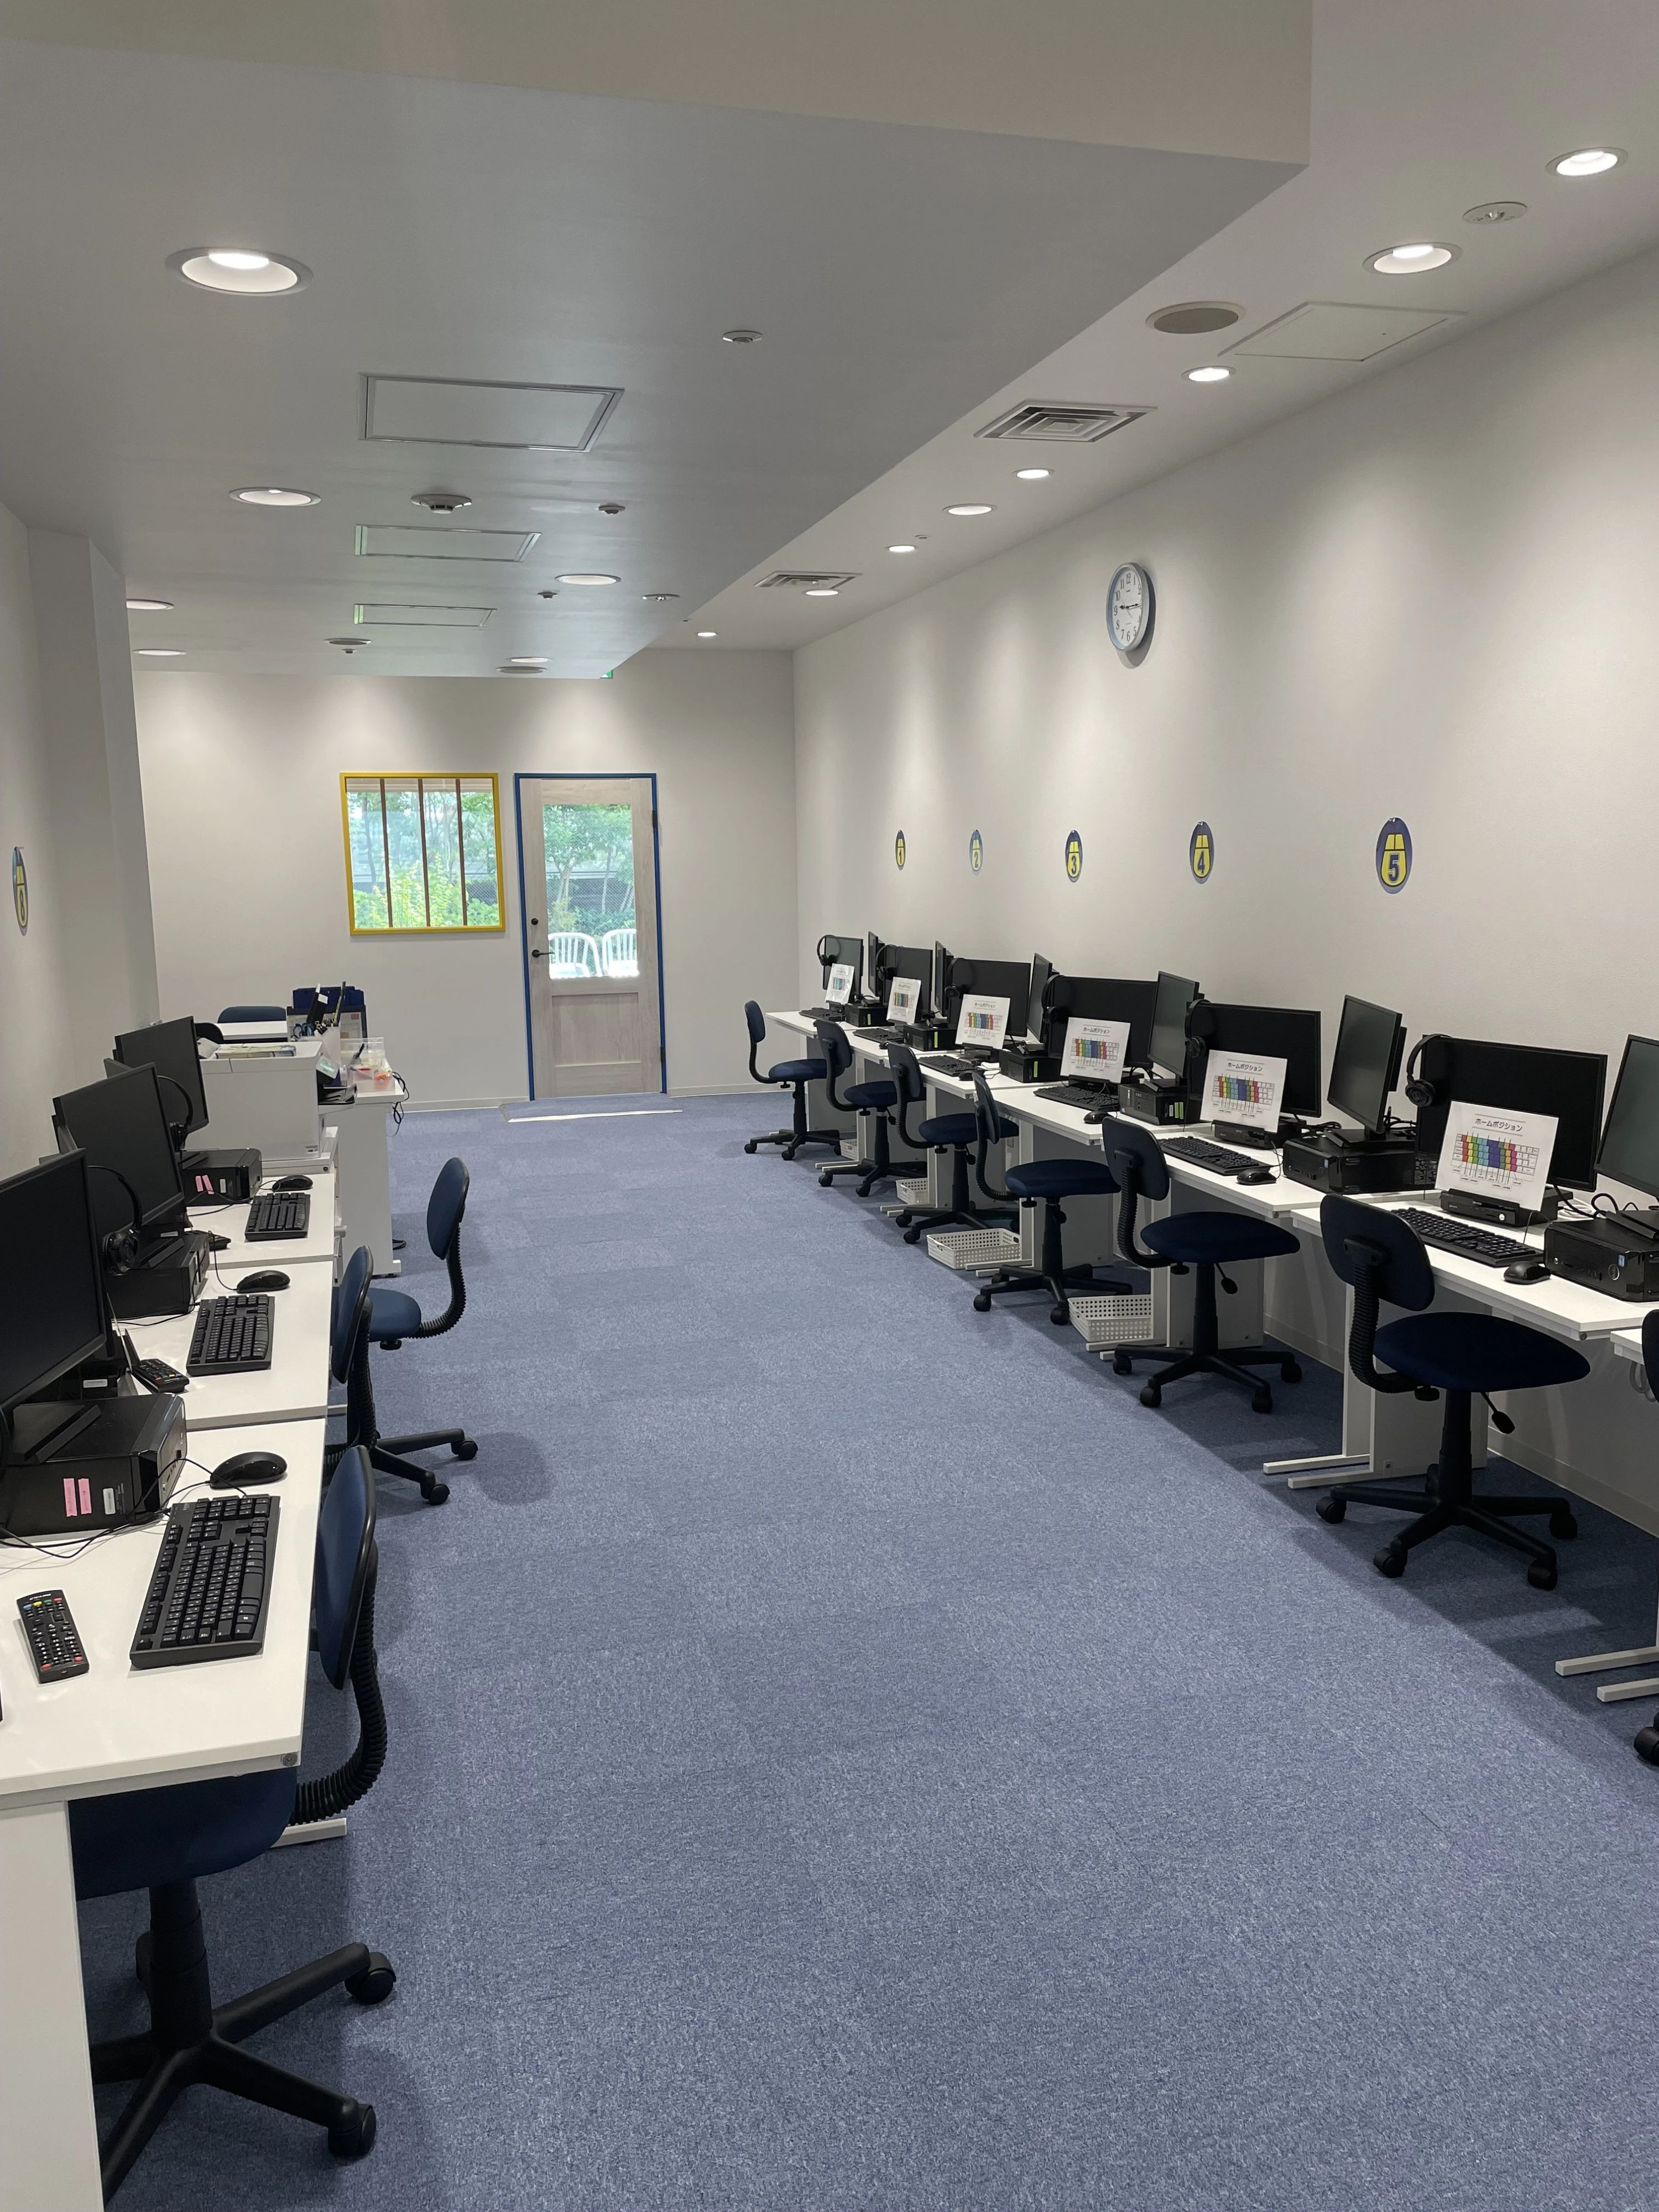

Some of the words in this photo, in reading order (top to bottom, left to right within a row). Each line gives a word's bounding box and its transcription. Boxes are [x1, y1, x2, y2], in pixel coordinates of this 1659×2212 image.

[1120, 579, 1124, 589] 11
[1126, 573, 1131, 585] 12
[1115, 590, 1120, 601] 10
[1114, 606, 1118, 616] 9
[1116, 619, 1119, 630] 8
[1121, 629, 1124, 639] 7
[1126, 631, 1130, 641] 6
[1133, 626, 1136, 637] 5
[974, 852, 979, 868] 2
[1071, 854, 1077, 874] 3
[1197, 850, 1205, 874] 4
[1388, 853, 1399, 883] 5
[1228, 1062, 1262, 1072] ホームポジション
[1475, 1118, 1522, 1132] ホームポジション
